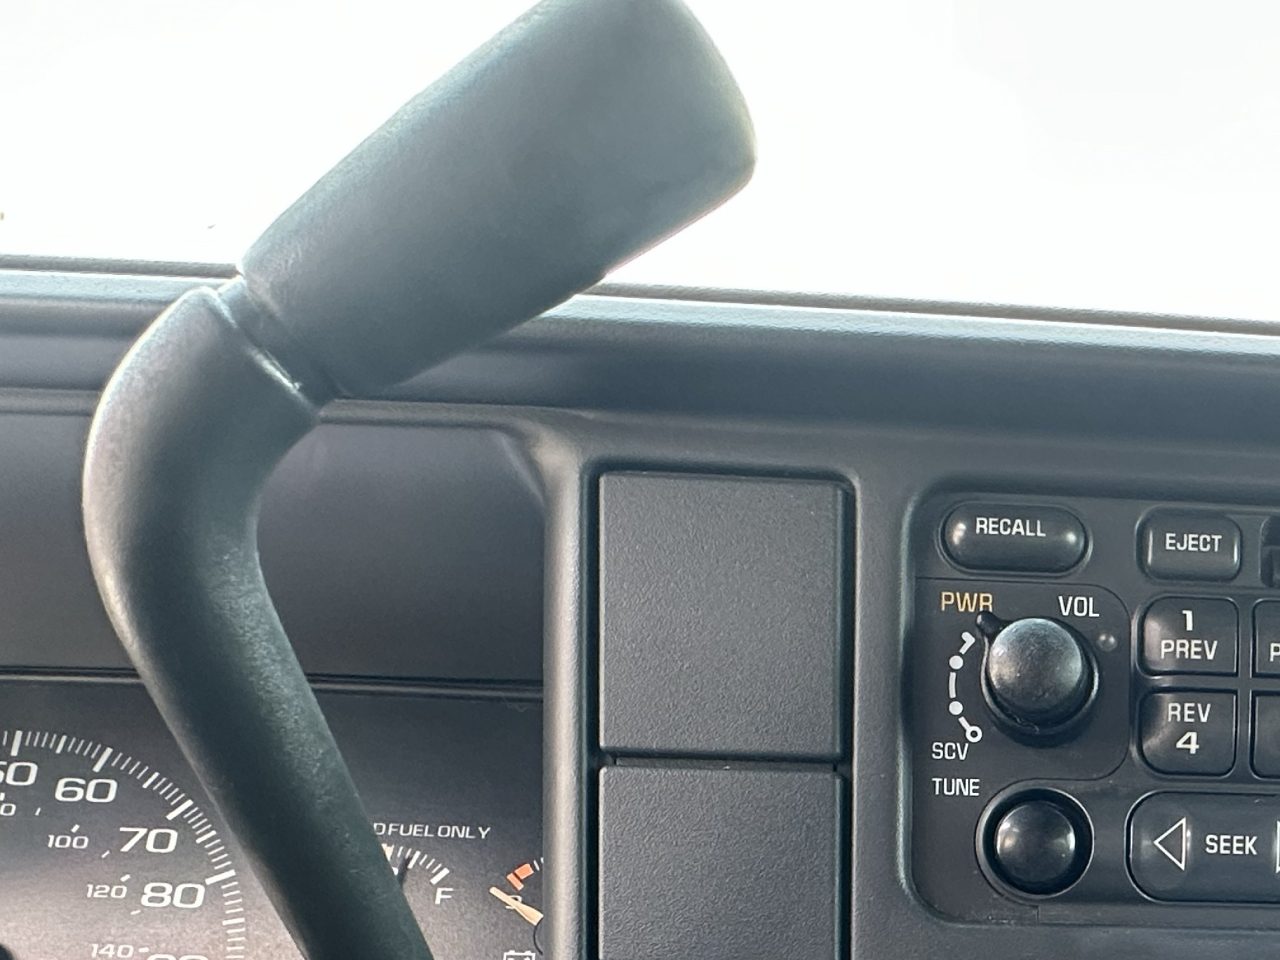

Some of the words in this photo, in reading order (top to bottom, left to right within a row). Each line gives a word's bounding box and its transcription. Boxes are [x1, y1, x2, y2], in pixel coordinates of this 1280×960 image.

[975, 517, 1047, 537] RECALL
[1165, 532, 1223, 552] EJECT
[941, 591, 993, 613] PWR
[1058, 595, 1100, 618] VOL
[1182, 609, 1193, 631] 1
[1159, 638, 1218, 660] PREV
[1167, 702, 1211, 723] REV
[931, 743, 969, 761] SCV
[1175, 731, 1200, 755] 4
[54, 777, 118, 803] 60
[931, 777, 981, 797] TUNE
[0, 803, 17, 817] 0
[119, 826, 179, 854] 70
[387, 822, 435, 838] FUEL
[437, 825, 491, 839] ONLY
[47, 834, 89, 849] 100
[1205, 834, 1258, 856] SEEK
[86, 883, 128, 899] 120
[140, 882, 206, 909] 80
[434, 887, 454, 905] F
[91, 943, 135, 959] 140
